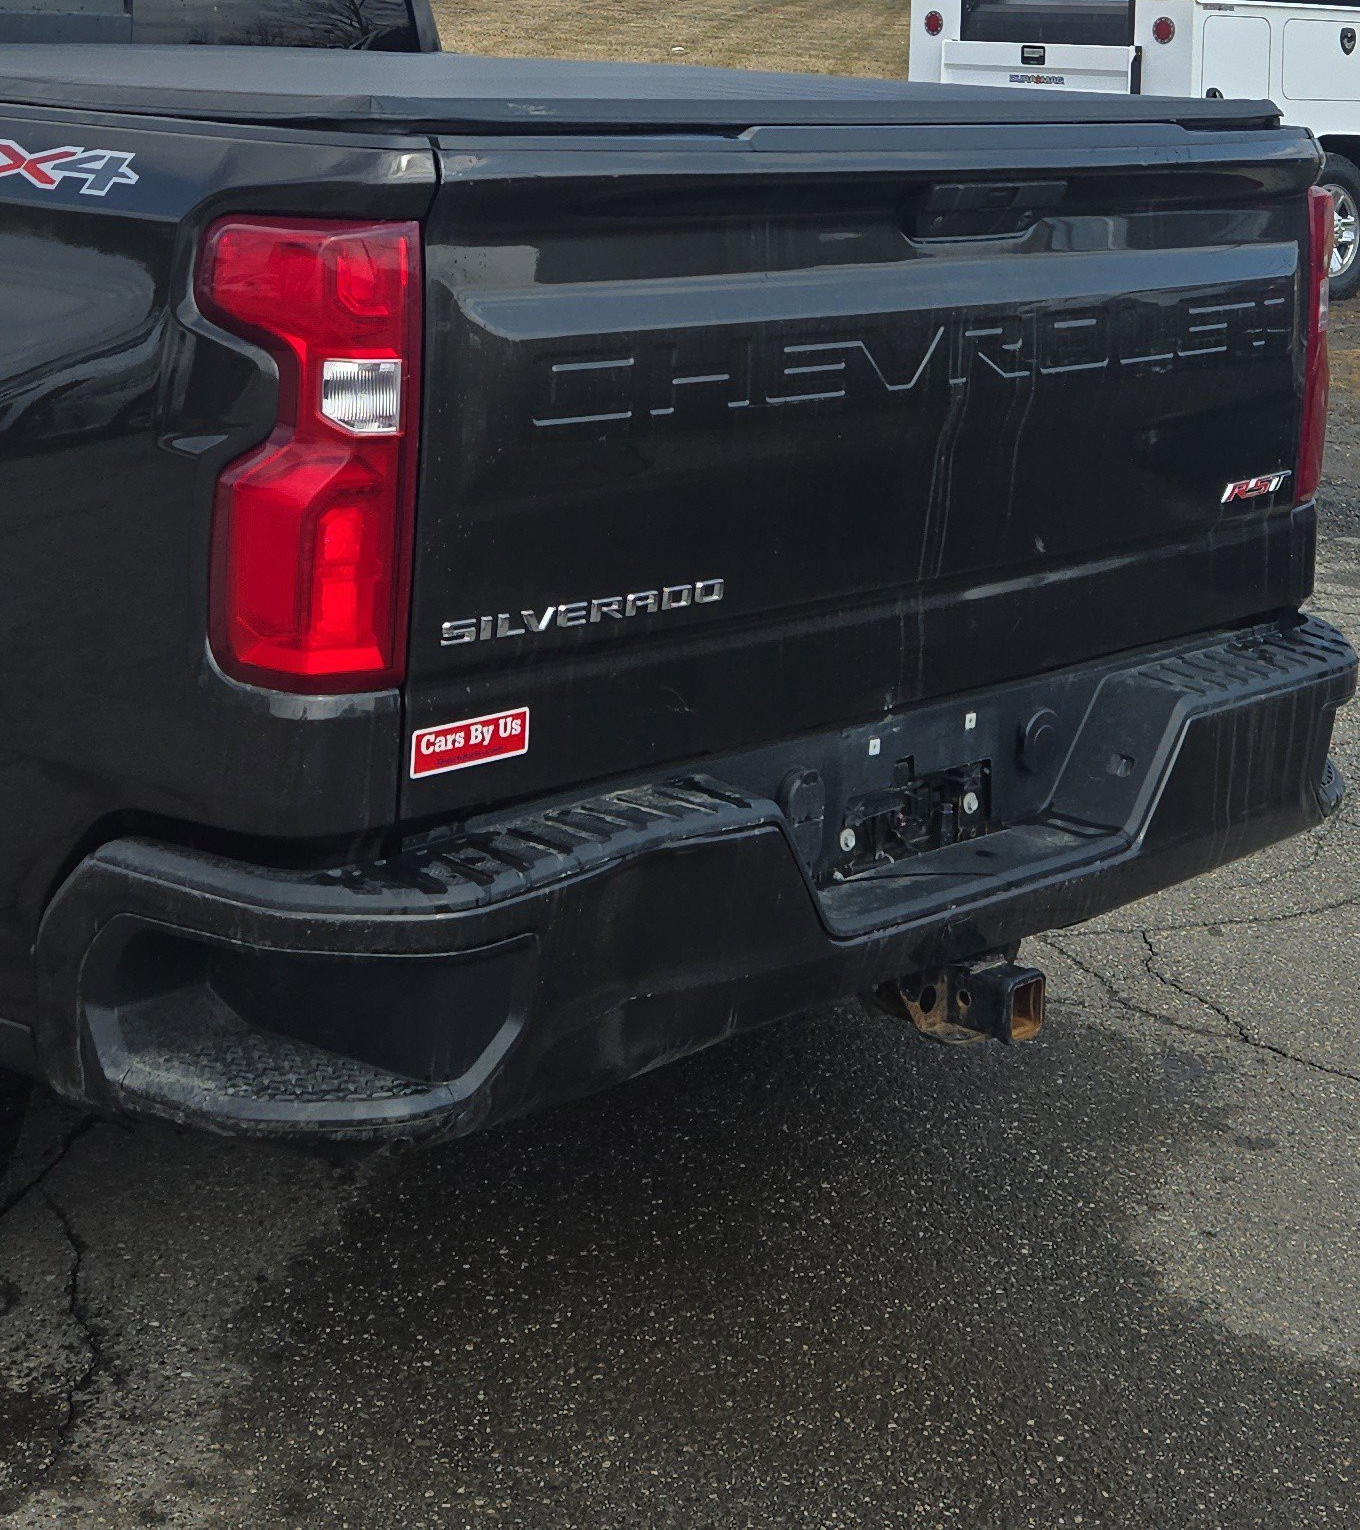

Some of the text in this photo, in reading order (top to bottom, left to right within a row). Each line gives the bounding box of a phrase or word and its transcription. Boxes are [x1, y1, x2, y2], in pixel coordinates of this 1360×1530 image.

[532, 297, 1286, 427] CHEVROLET
[1220, 470, 1292, 504] RST
[440, 578, 726, 647] SILVERADO
[420, 730, 466, 755] Cars
[469, 724, 495, 746] By
[498, 716, 522, 738] Us
